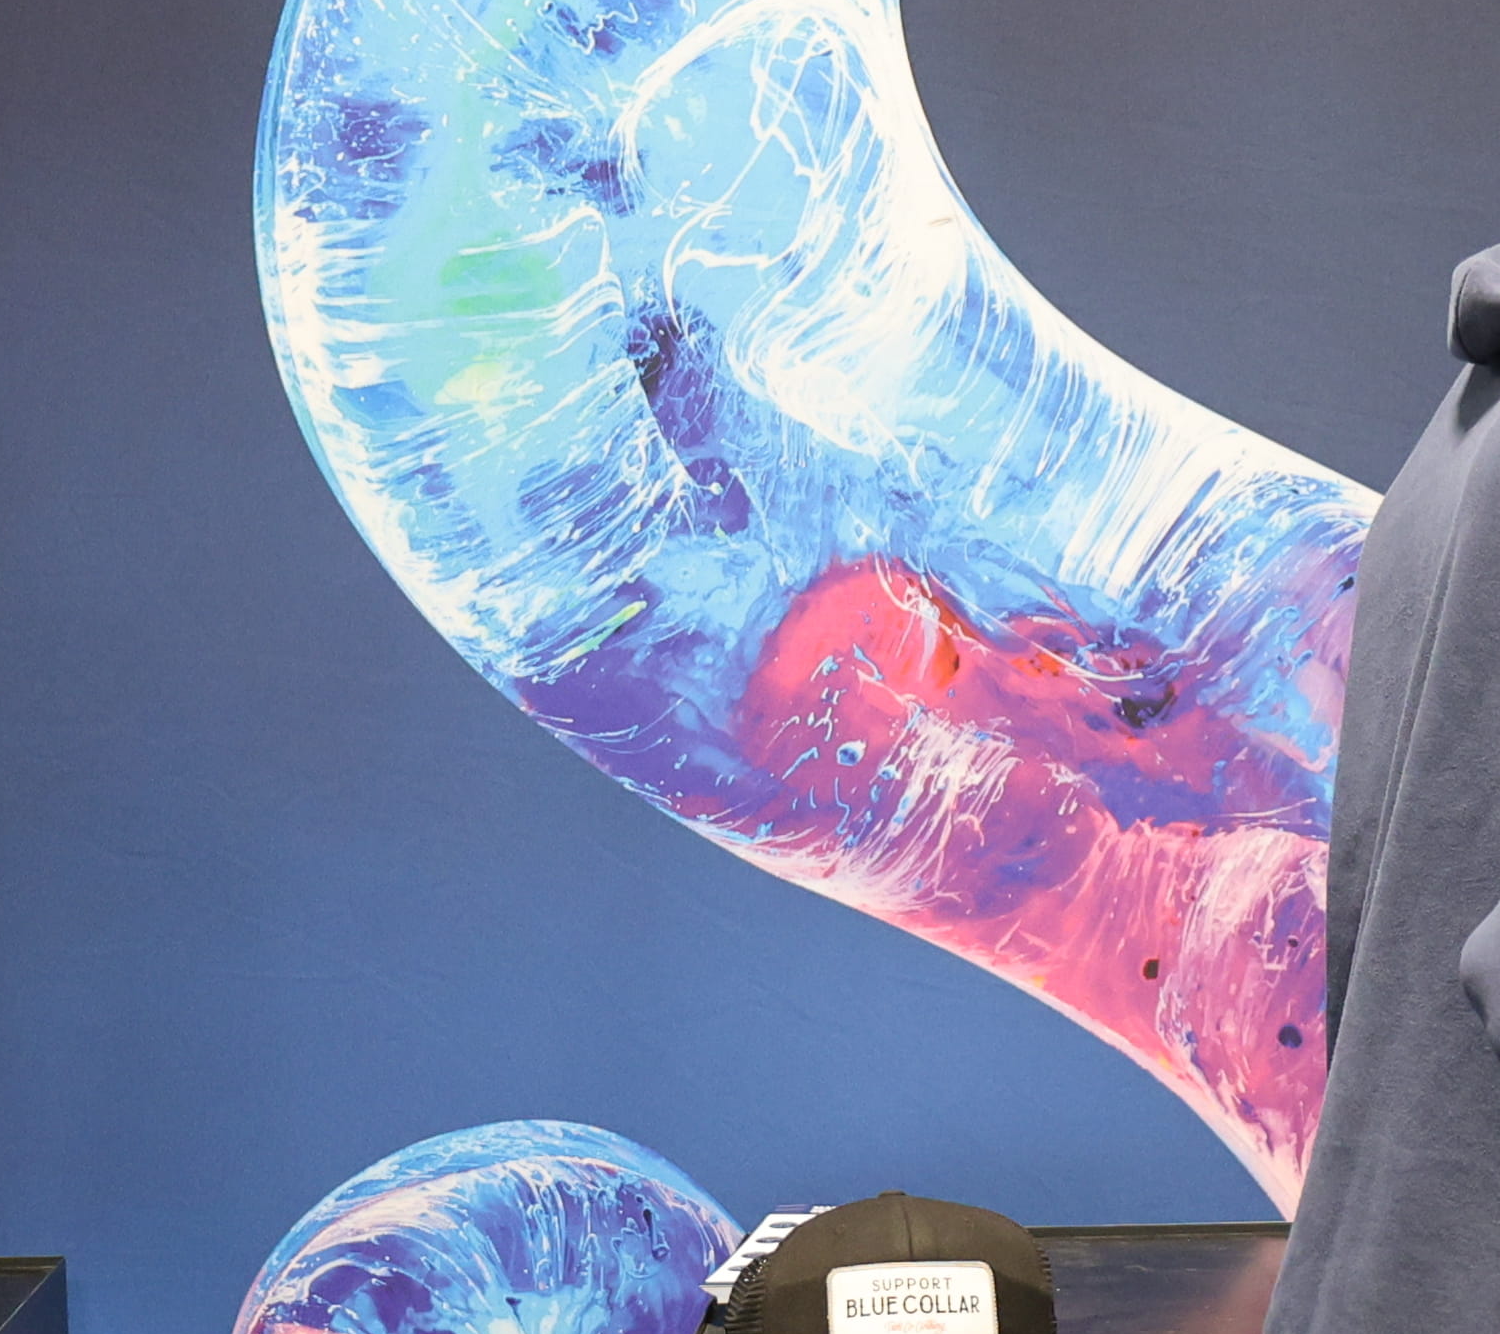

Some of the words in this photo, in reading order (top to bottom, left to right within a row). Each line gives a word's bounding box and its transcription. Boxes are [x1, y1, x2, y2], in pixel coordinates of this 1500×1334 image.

[872, 1277, 952, 1292] SUPPORT
[846, 1296, 899, 1319] BLUE
[903, 1294, 981, 1315] COLLAR
